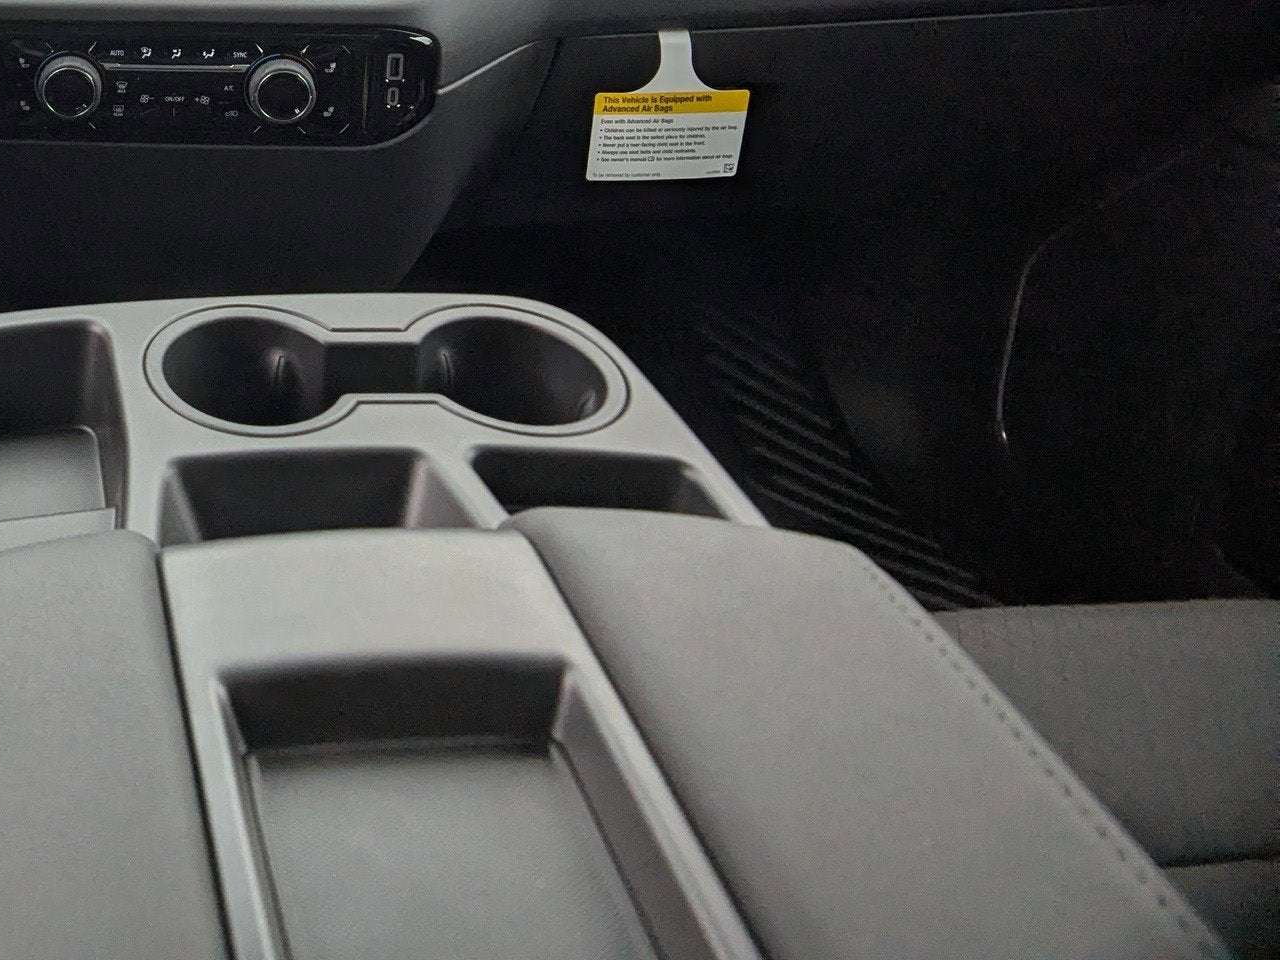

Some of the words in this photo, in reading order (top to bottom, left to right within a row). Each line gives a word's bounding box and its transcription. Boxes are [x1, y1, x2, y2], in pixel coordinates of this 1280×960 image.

[604, 96, 619, 104] This
[660, 95, 694, 104] Equipped
[654, 105, 673, 113] Bags
